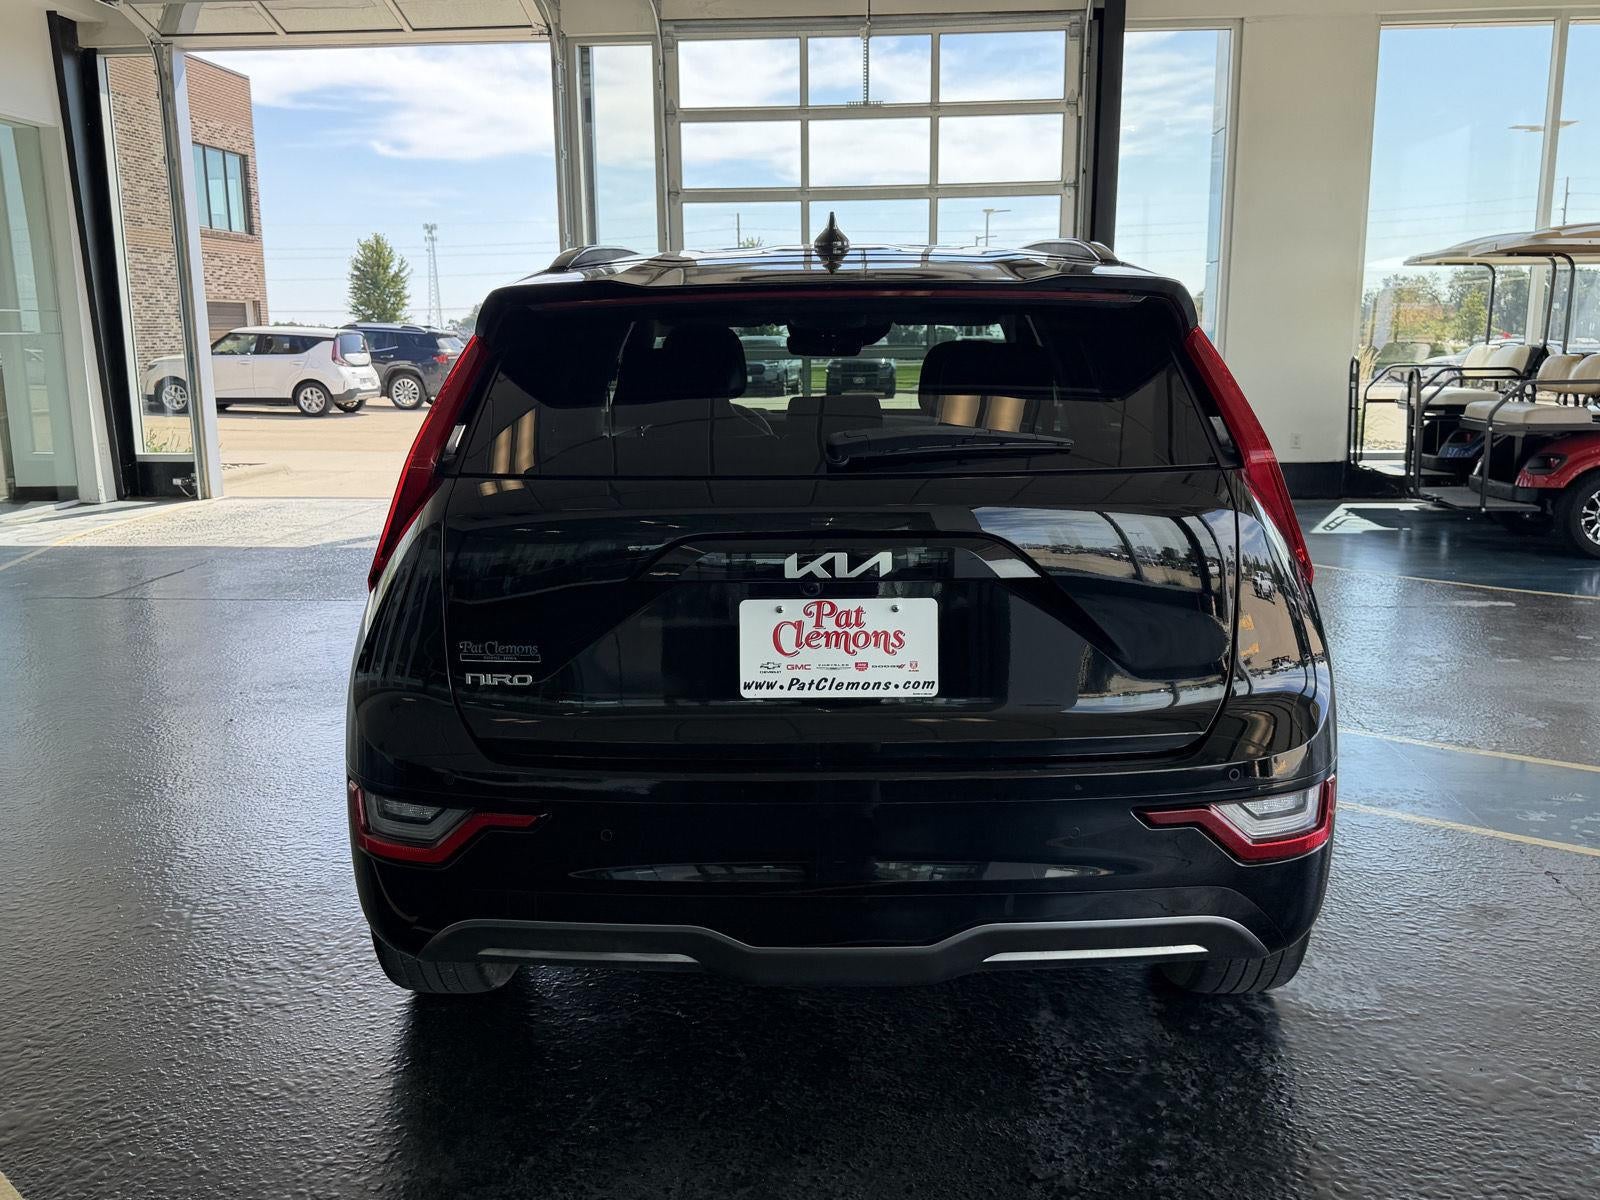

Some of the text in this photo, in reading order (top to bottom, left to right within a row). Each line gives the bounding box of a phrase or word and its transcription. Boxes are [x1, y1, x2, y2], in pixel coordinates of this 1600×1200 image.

[784, 551, 893, 578] KIA
[803, 600, 866, 629] Pat
[460, 640, 538, 656] Pat Clemons
[772, 620, 905, 658] Clemons
[465, 673, 533, 686] NIRO
[743, 677, 936, 691] www.PatClemons.com
